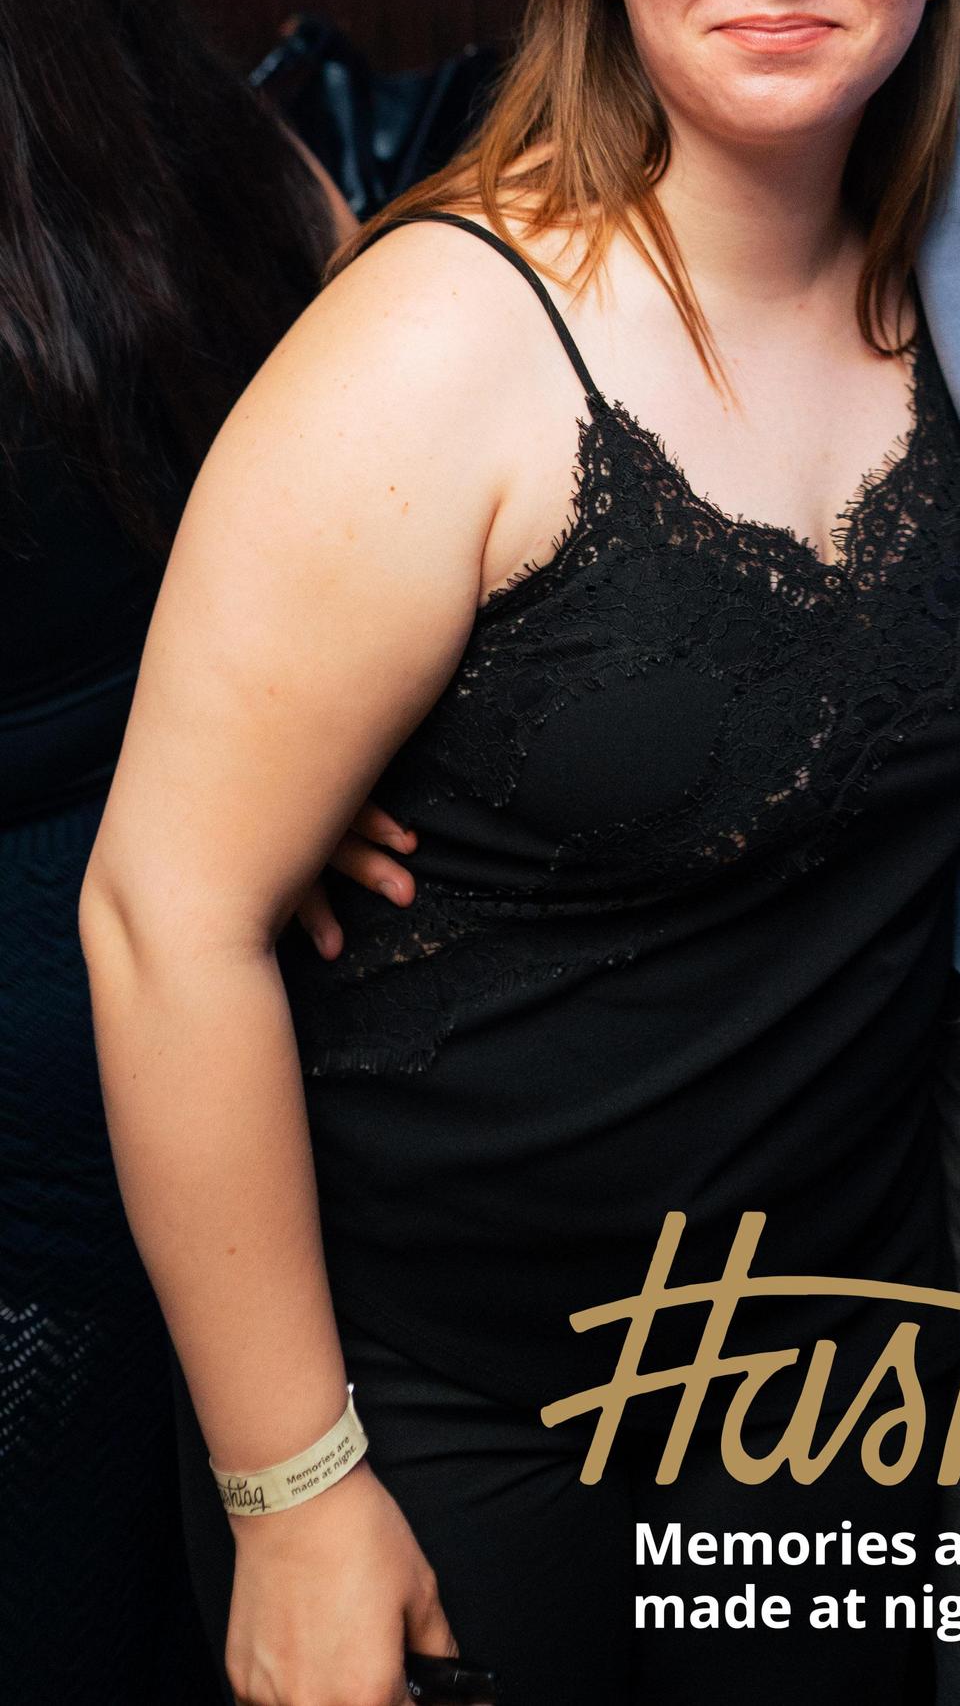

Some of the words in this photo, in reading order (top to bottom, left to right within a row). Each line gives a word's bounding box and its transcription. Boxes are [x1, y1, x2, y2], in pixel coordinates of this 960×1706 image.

[286, 1451, 336, 1485] Memories
[337, 1436, 350, 1453] are
[291, 1477, 320, 1496] made
[322, 1467, 333, 1479] at
